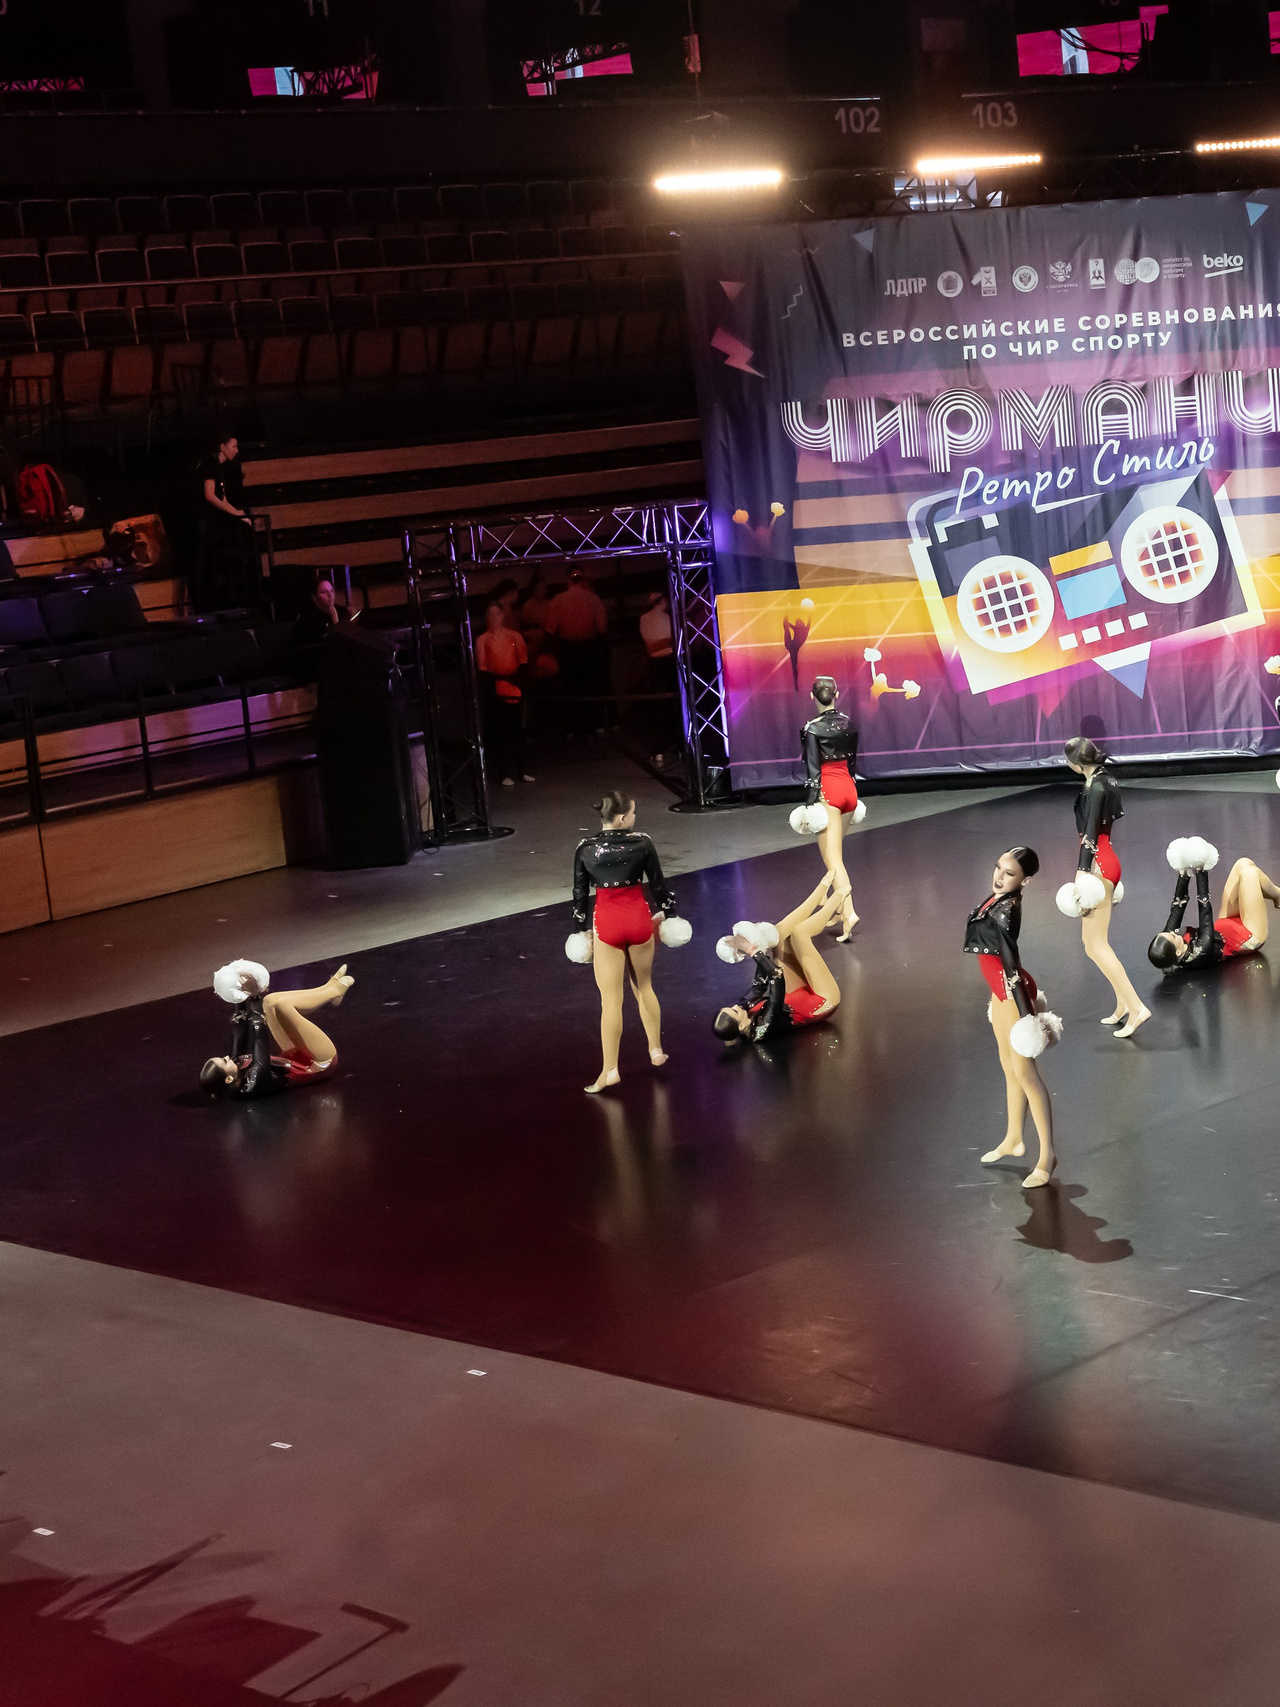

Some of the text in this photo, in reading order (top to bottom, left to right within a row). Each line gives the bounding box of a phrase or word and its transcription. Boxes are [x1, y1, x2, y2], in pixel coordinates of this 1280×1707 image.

[834, 106, 881, 134] 102
[972, 101, 1018, 128] 103
[1203, 253, 1244, 269] beko
[884, 277, 927, 297] ЛДПР
[842, 317, 1066, 348] ВСЕРОССИЙСКИЕ
[963, 331, 1172, 360] ПО ЧИР СПОРТУ
[955, 437, 1215, 515] Ретро Стиль
